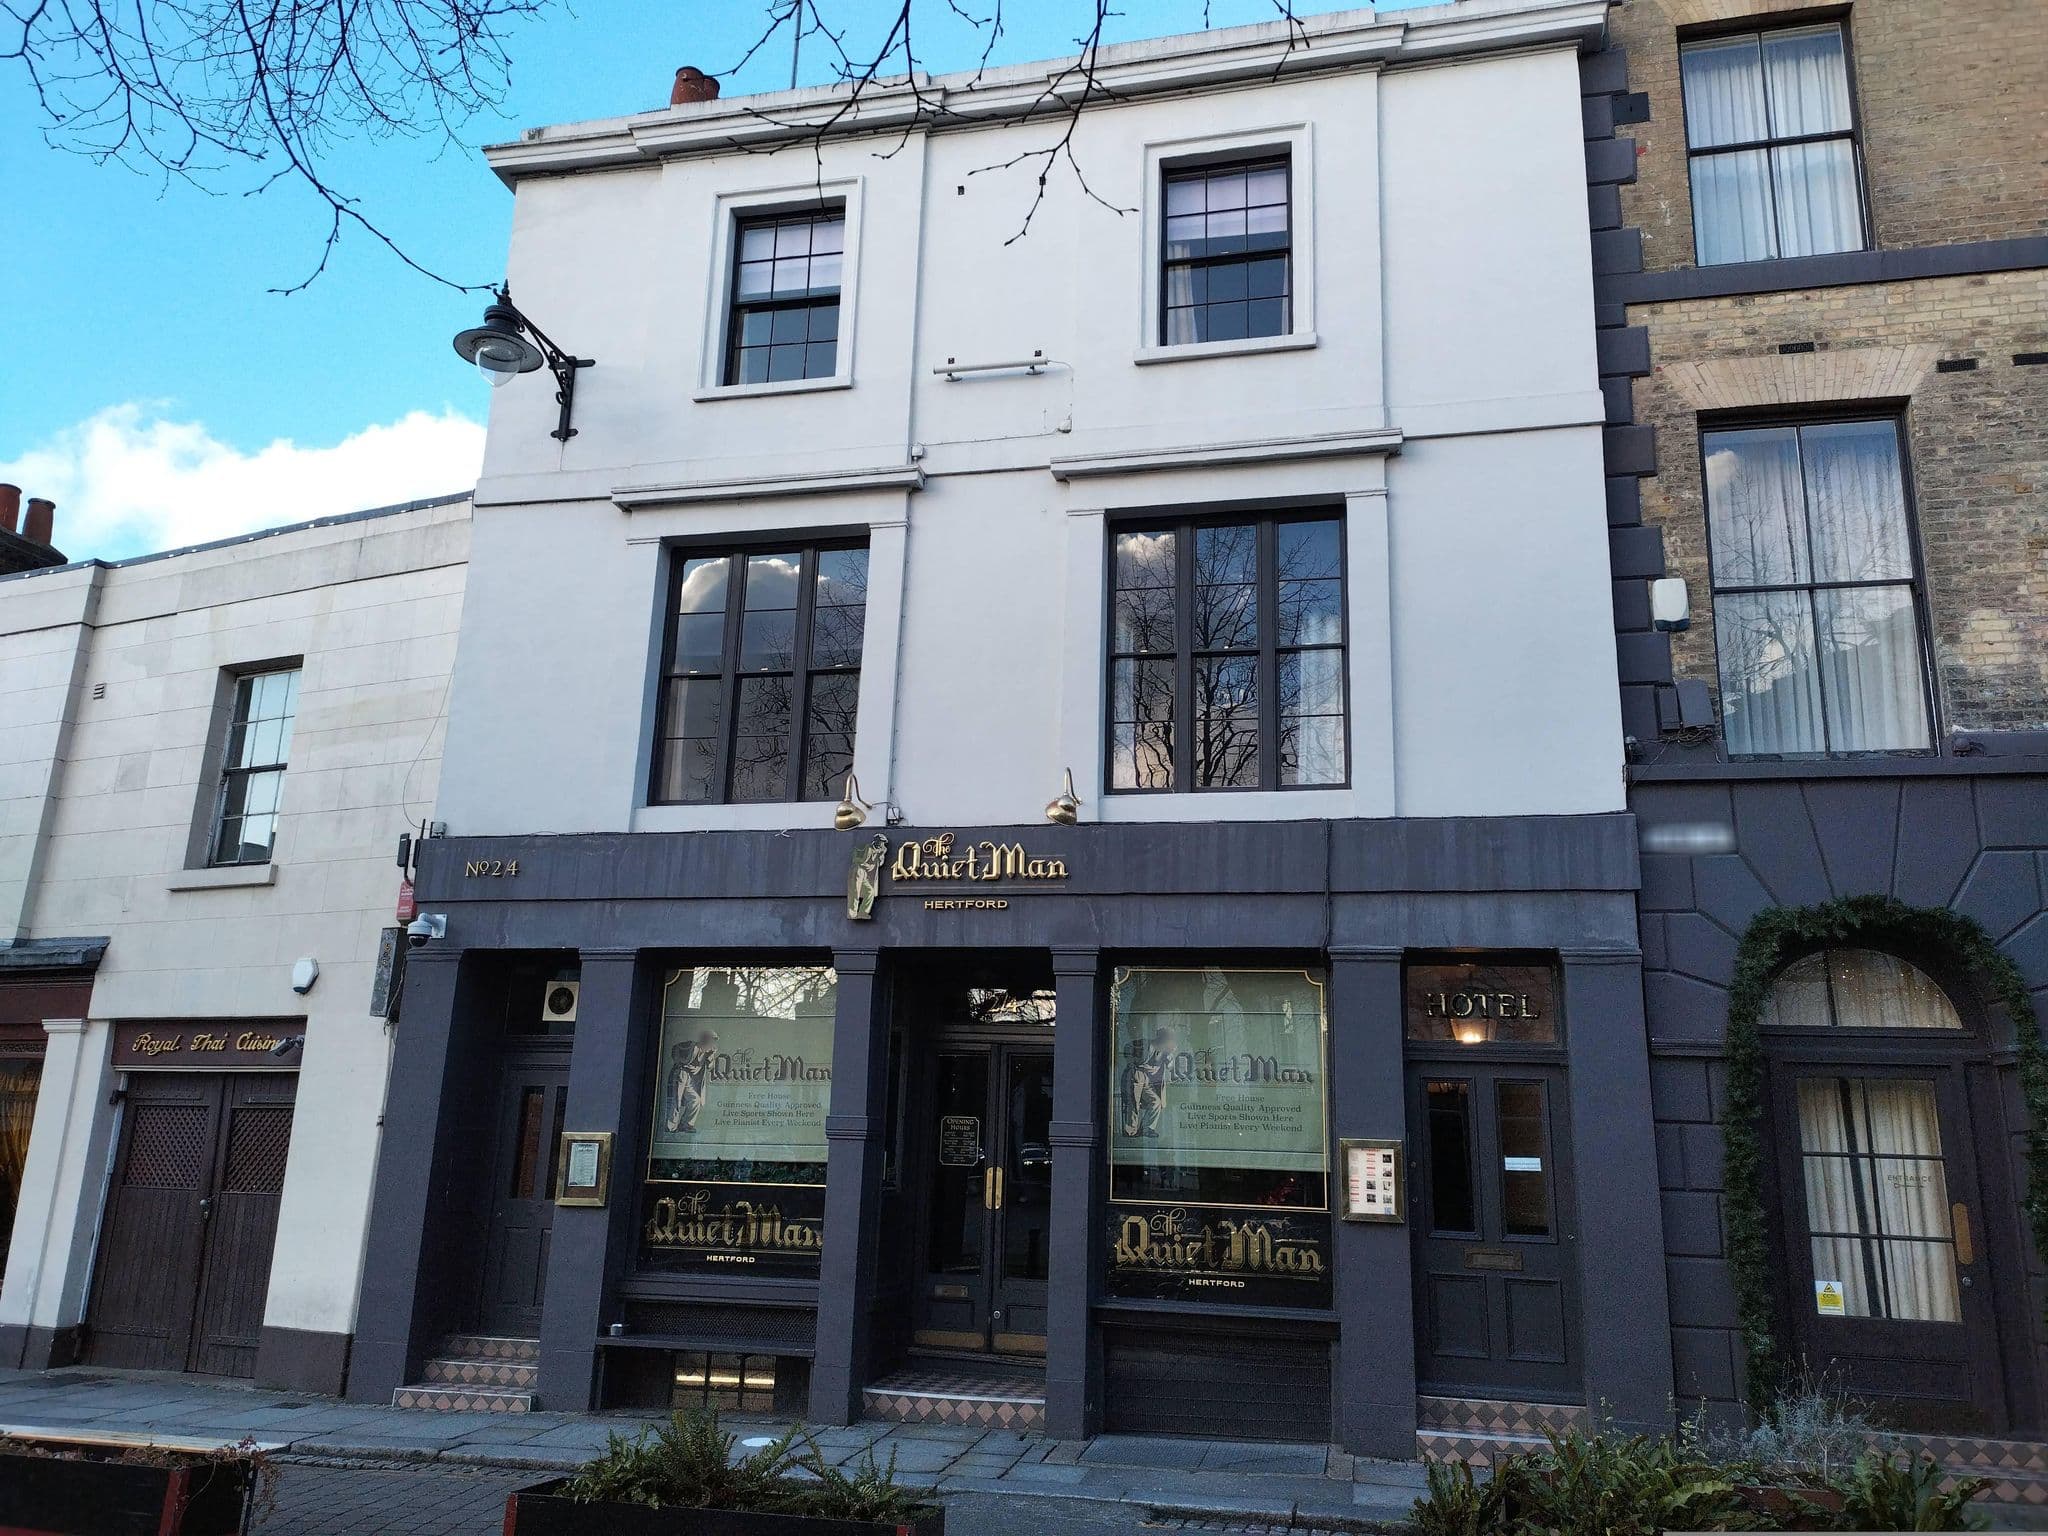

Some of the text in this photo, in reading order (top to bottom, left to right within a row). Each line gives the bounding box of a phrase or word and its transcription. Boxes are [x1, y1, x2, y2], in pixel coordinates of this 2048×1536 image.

[922, 832, 954, 858] The
[891, 841, 1068, 881] Quiet Man
[924, 900, 1008, 909] HERTFORD
[1424, 992, 1539, 1018] HOTEL
[190, 1032, 230, 1051] Thai
[236, 1031, 280, 1051] Cuisin
[708, 1053, 832, 1083] Quiet Man
[1167, 1052, 1314, 1084] Quiet Man
[1238, 1094, 1265, 1102] House
[785, 1102, 821, 1110] Approved
[1180, 1103, 1302, 1114] Guinness Quality Approved
[740, 1110, 765, 1119] Sports
[766, 1110, 793, 1118] Shown
[1208, 1113, 1237, 1122] Sports
[733, 1119, 760, 1127] Pianist
[761, 1119, 785, 1129] Every
[1179, 1122, 1303, 1133] Live Pianist Every Weekend
[678, 1190, 710, 1217] The
[646, 1197, 824, 1250] Quiet Man
[1150, 1208, 1187, 1235] The
[1114, 1215, 1325, 1274] Quiet Man
[706, 1255, 755, 1263] HERTFORD
[1188, 1278, 1245, 1288] HERTFORD
